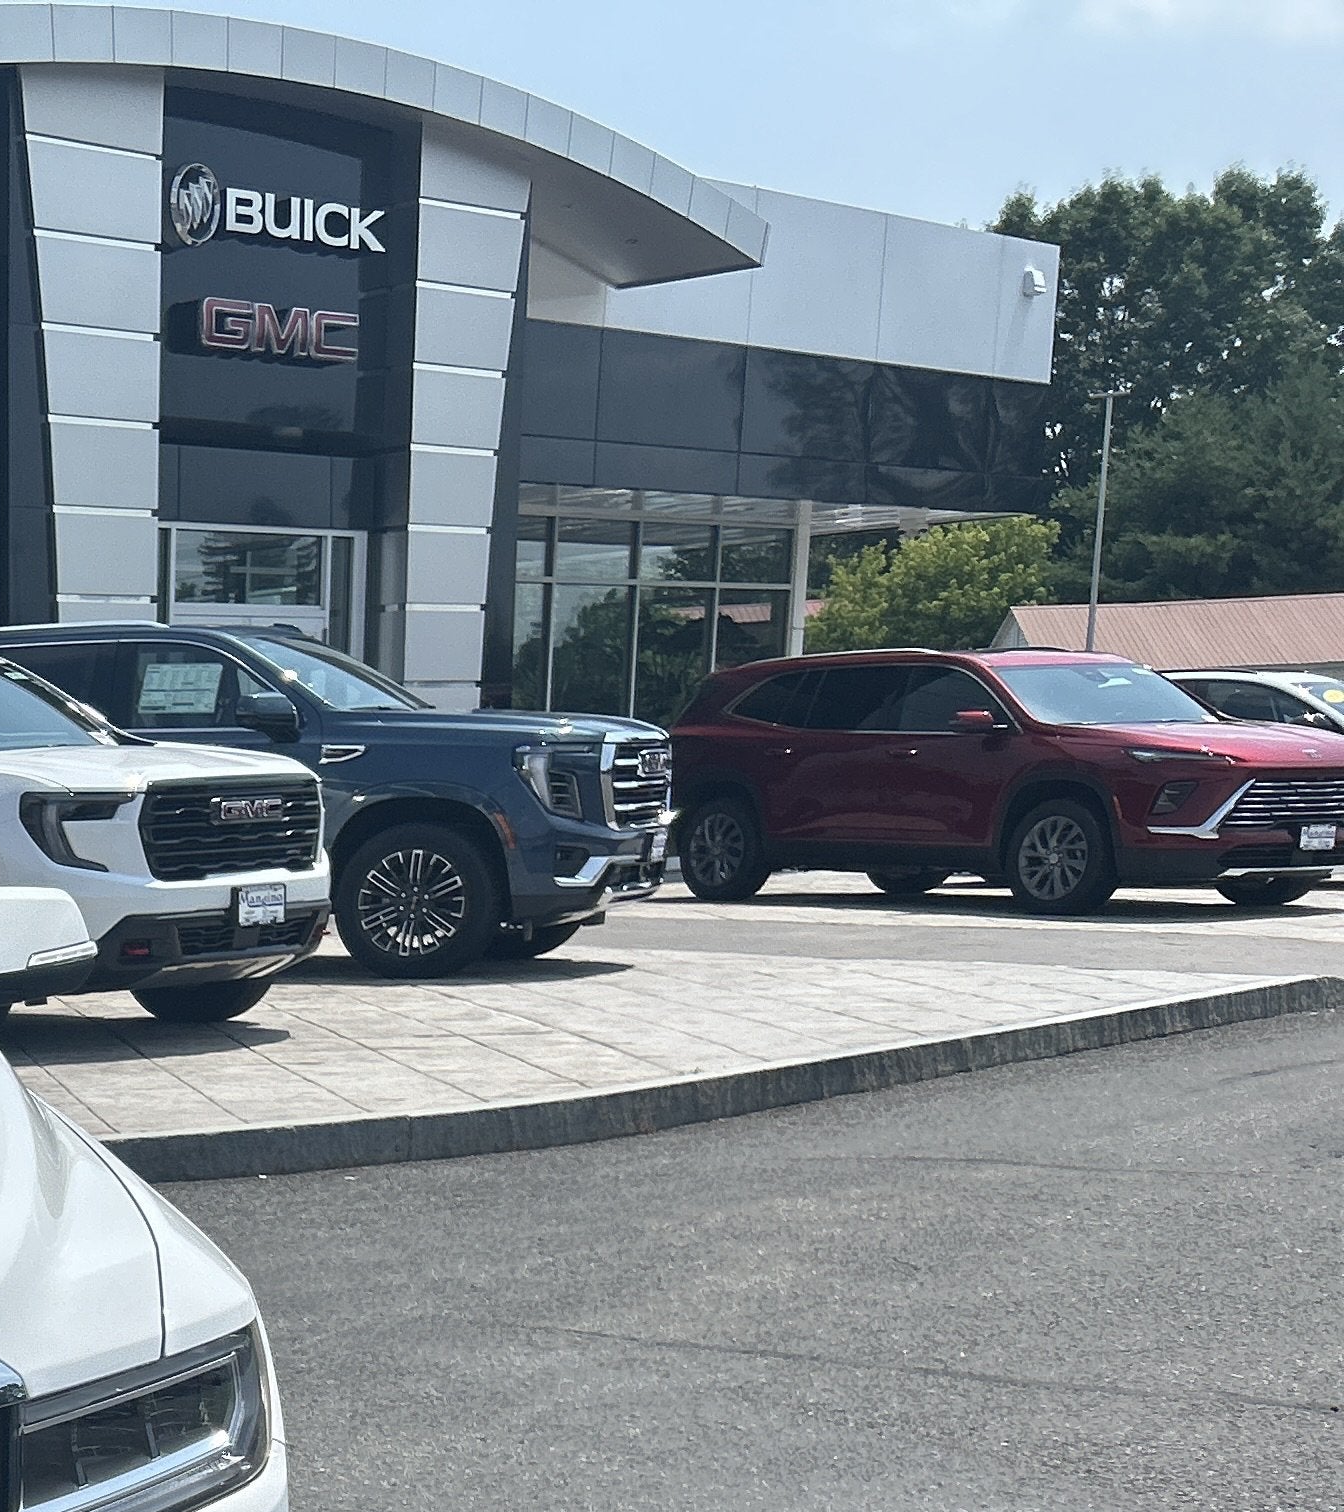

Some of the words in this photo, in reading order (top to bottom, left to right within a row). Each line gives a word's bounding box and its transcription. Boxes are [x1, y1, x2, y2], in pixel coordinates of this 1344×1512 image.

[226, 187, 386, 252] BUICK
[202, 297, 359, 361] GMC
[221, 799, 282, 820] GMC
